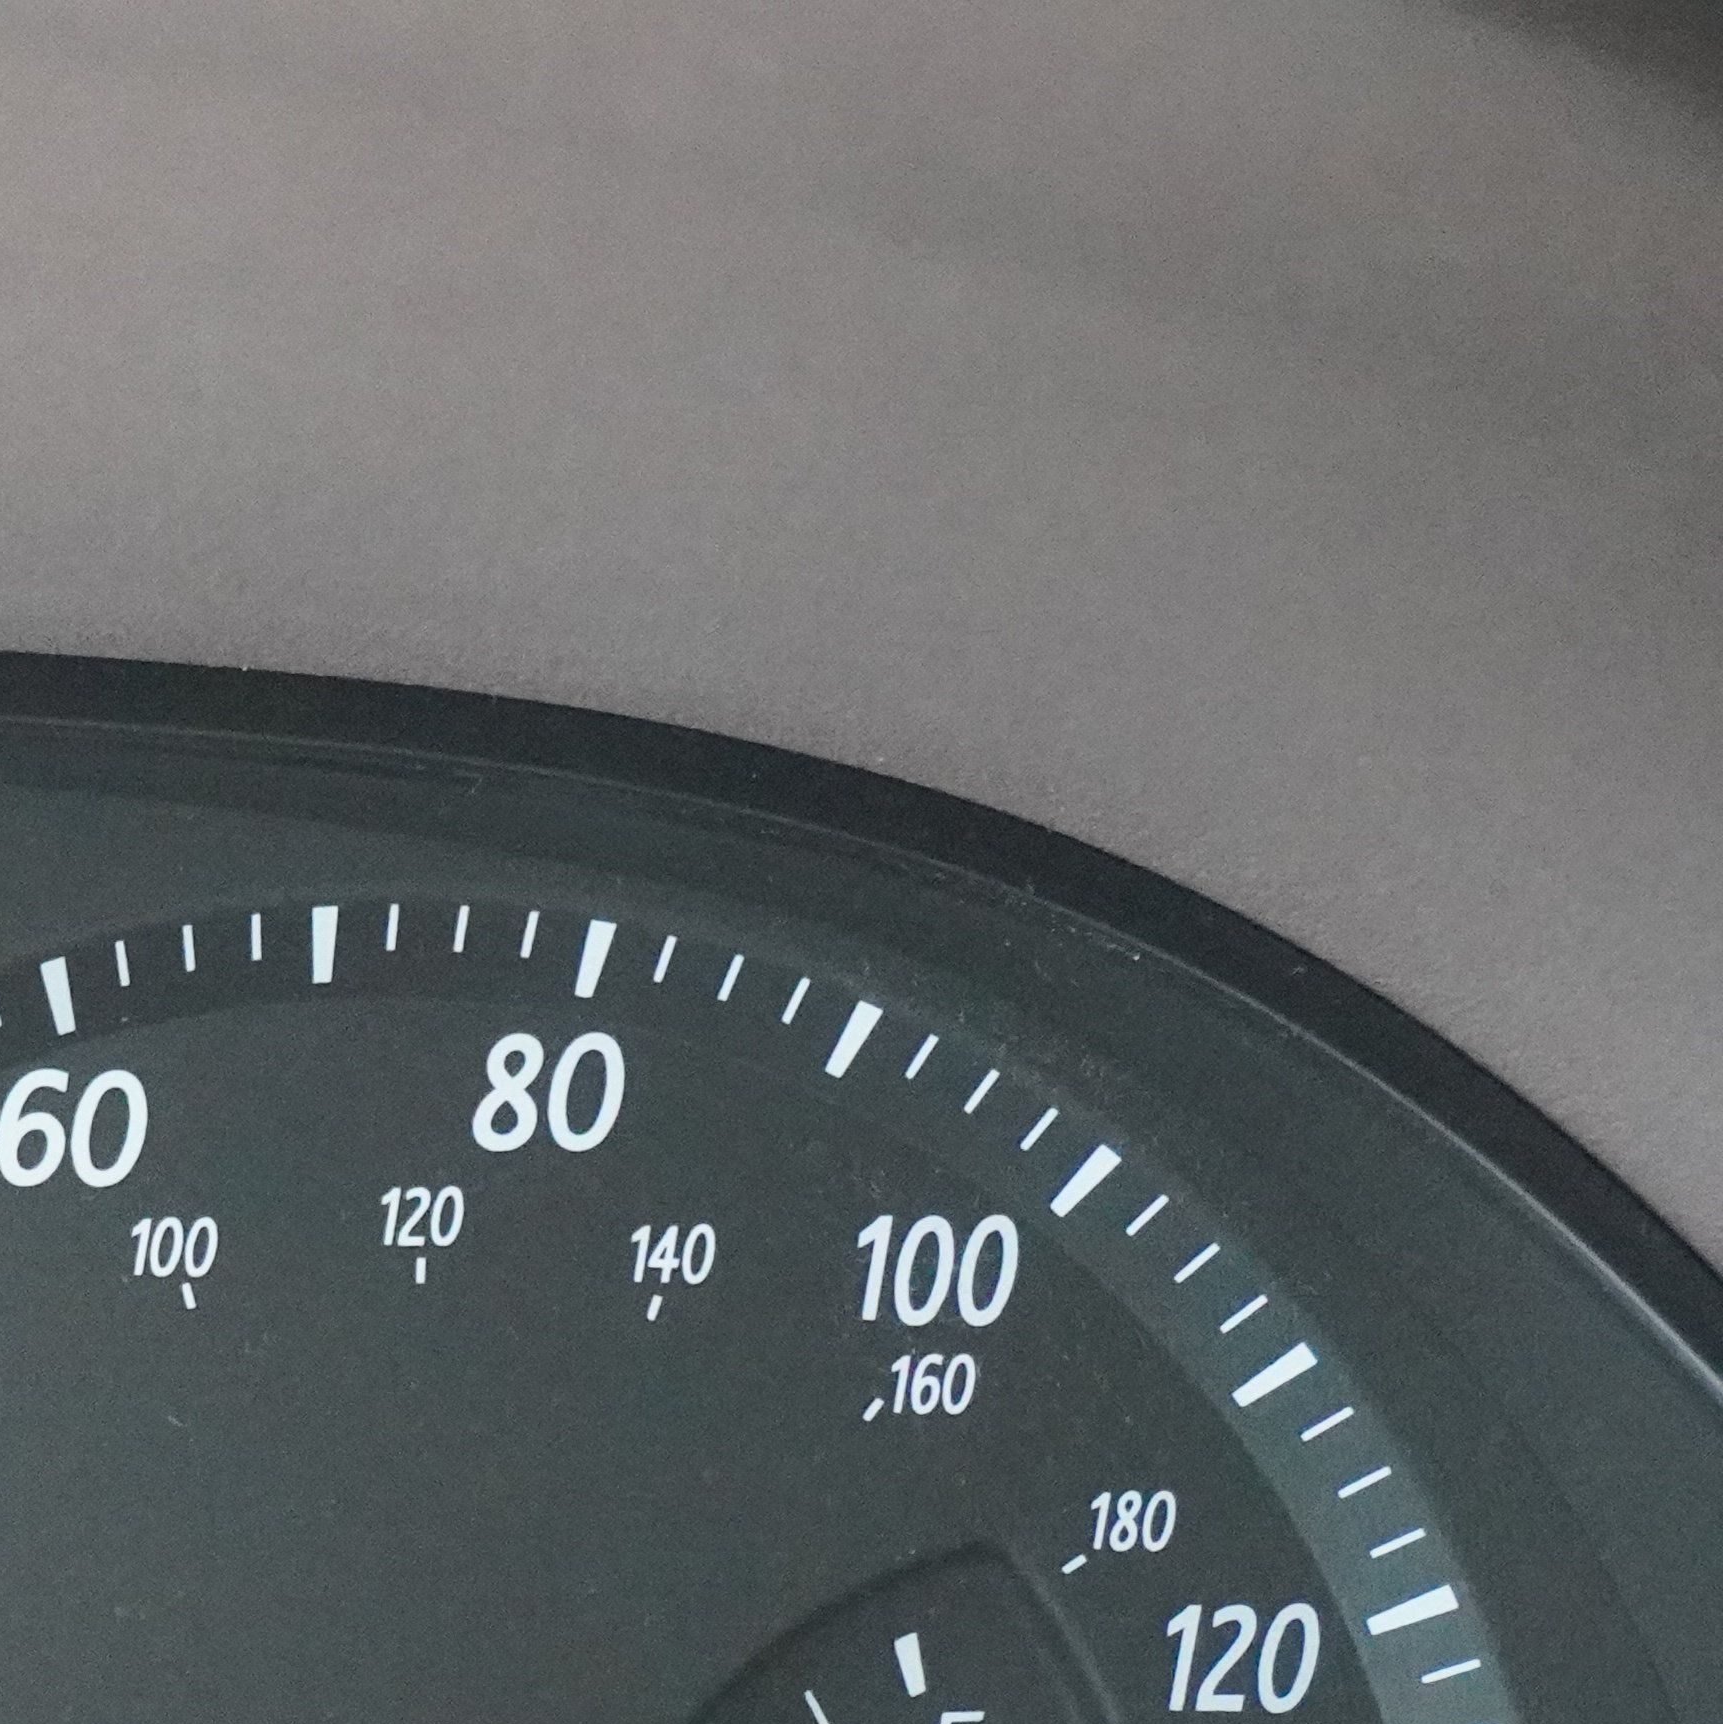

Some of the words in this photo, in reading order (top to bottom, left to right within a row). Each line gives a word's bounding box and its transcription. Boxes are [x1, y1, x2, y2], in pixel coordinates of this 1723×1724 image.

[473, 1032, 624, 1151] 80
[382, 1186, 464, 1246] 120
[132, 1217, 217, 1277] 100
[632, 1224, 715, 1284] 140
[858, 1215, 1018, 1326] 100
[892, 1354, 975, 1414] 160
[1091, 1491, 1176, 1551] 180
[1167, 1603, 1320, 1713] 120
